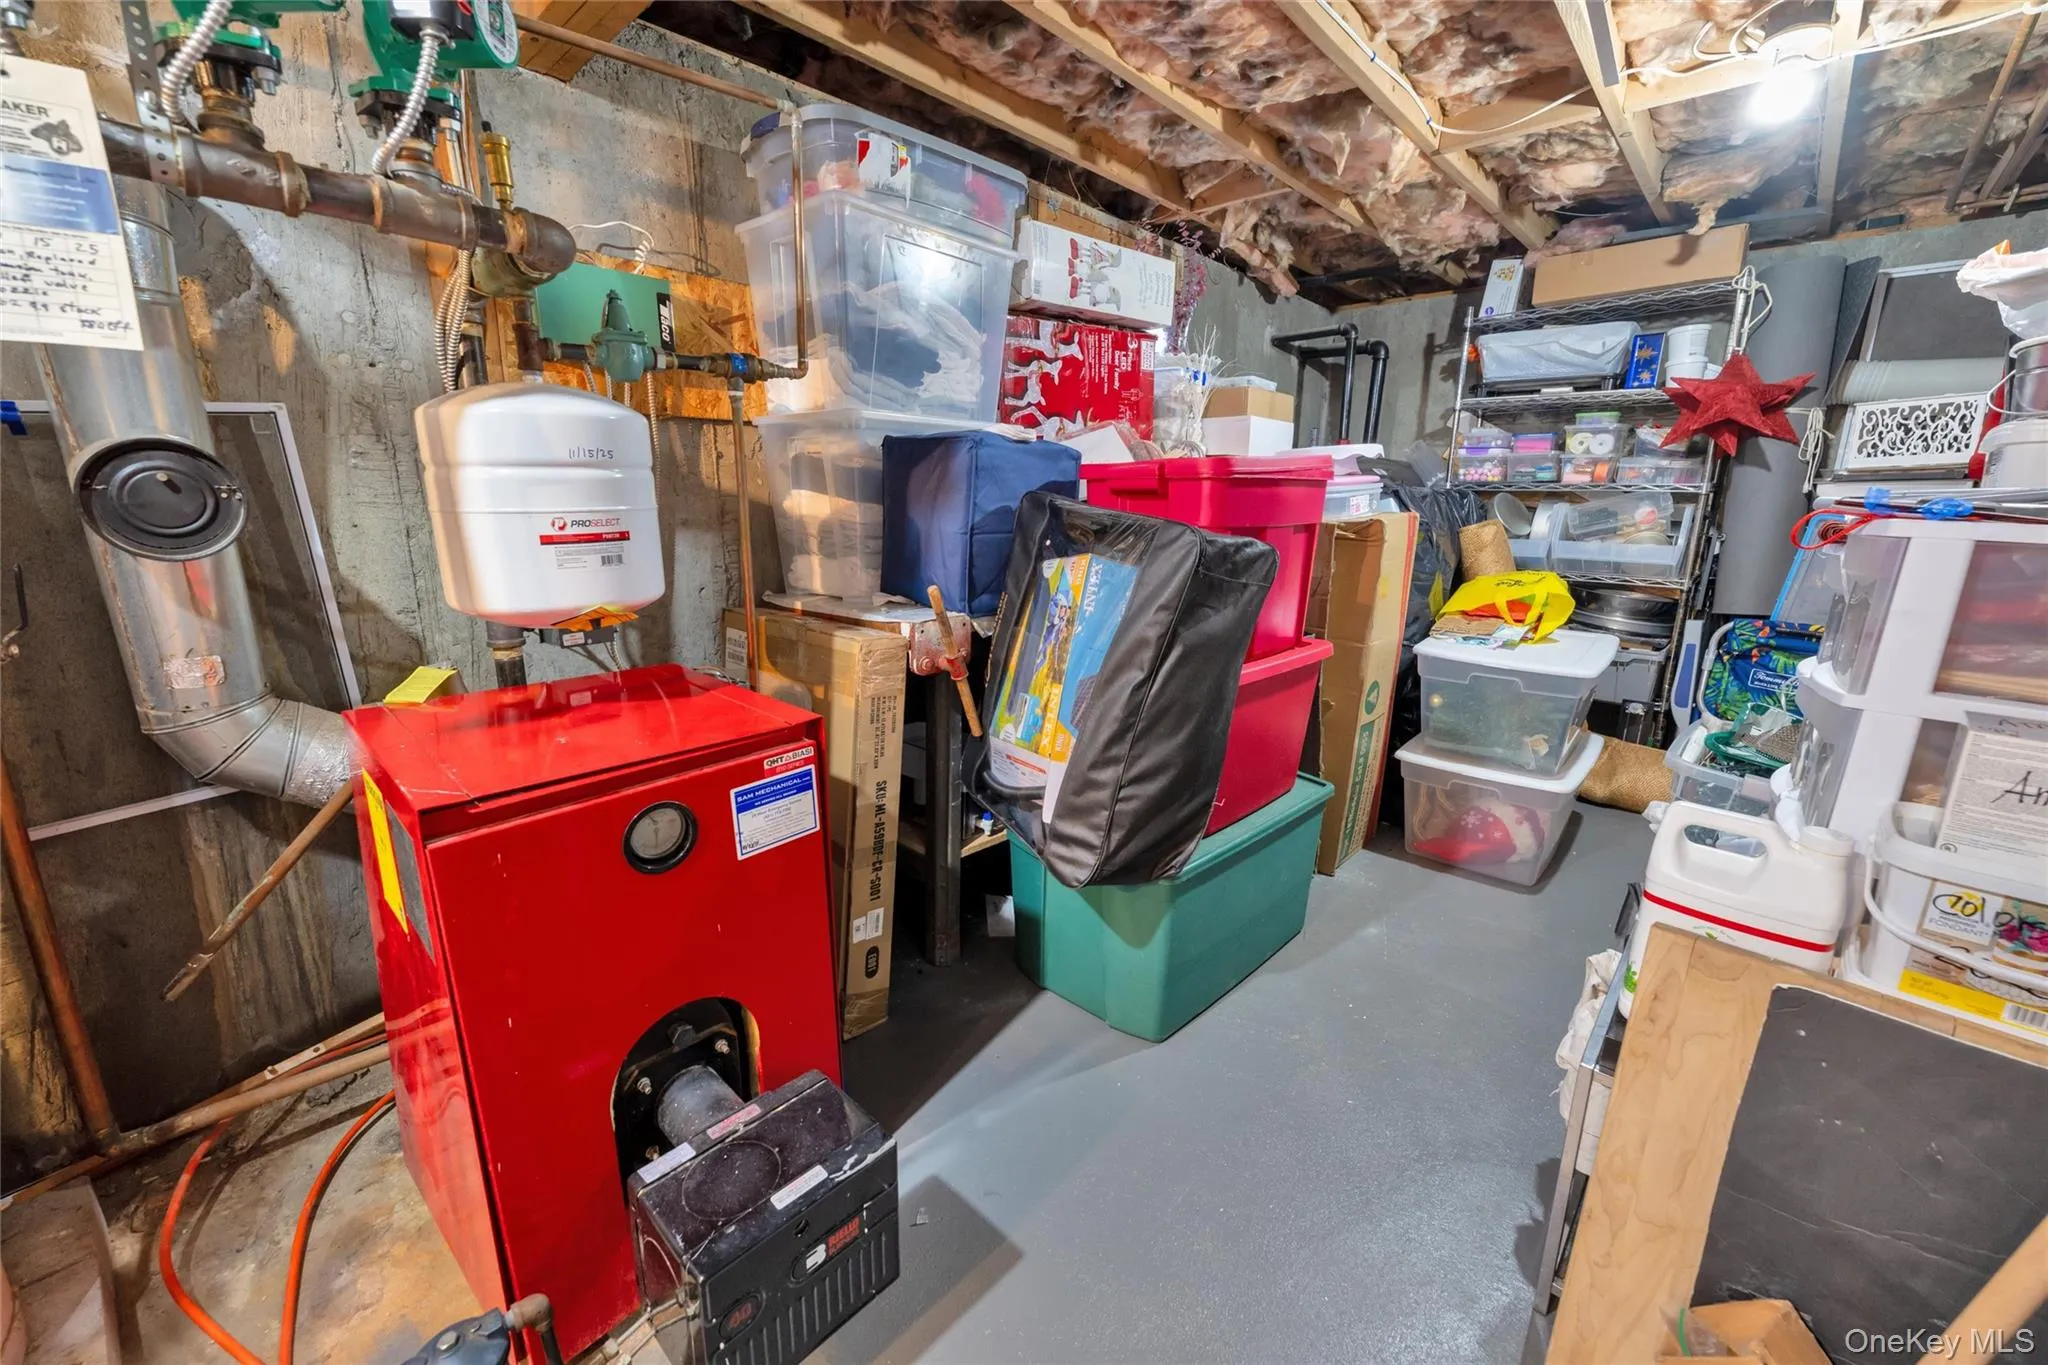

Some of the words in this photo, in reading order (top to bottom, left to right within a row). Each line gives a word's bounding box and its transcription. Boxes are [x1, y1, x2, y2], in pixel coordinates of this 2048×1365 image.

[74, 242, 98, 256] 25
[659, 300, 673, 342] Taco
[571, 517, 621, 528] PROSELECT
[1041, 687, 1060, 749] INTEX
[766, 756, 785, 767] QHT
[792, 748, 812, 759] BIASI
[737, 793, 754, 802] SAM
[755, 777, 802, 797] MECHANICAL
[1928, 917, 1984, 937] FONDANT
